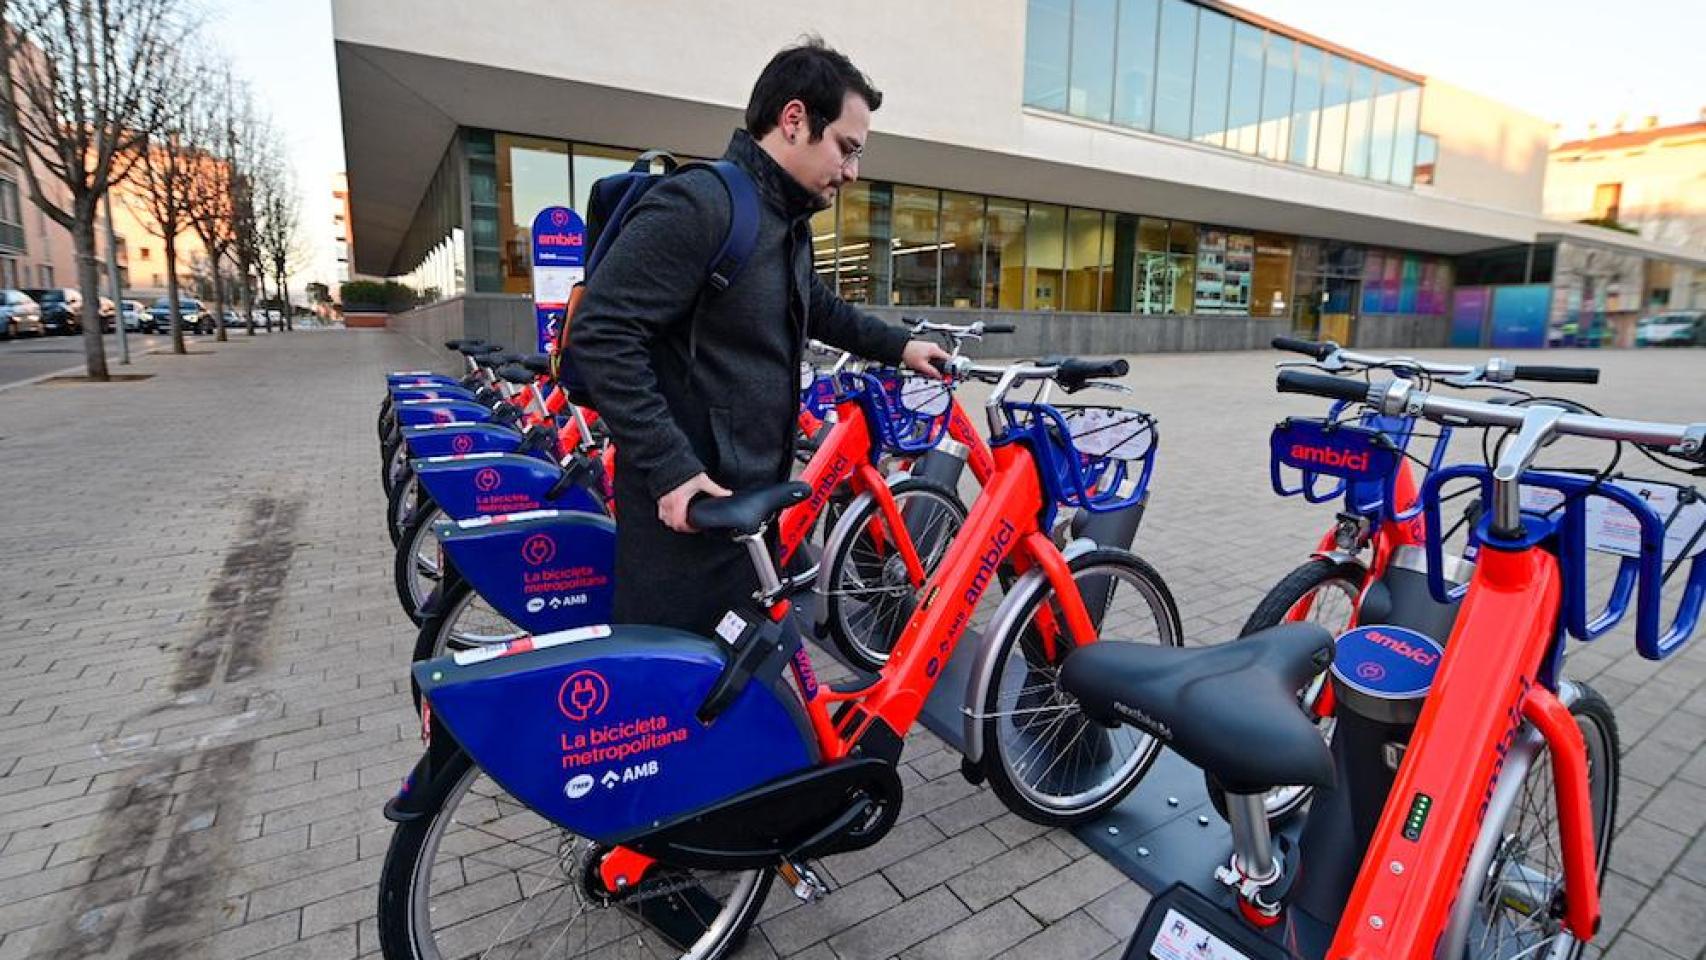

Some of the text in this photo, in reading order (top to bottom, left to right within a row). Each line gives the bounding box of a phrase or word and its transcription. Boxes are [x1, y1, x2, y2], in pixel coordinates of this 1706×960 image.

[538, 232, 582, 246] ambici
[1291, 444, 1369, 471] ambici
[965, 518, 1015, 606] ambici
[524, 572, 540, 582] La
[562, 593, 588, 606] AMB
[1365, 631, 1438, 665] ambici
[561, 716, 667, 751] La bicicleta
[562, 728, 688, 768] metropolitana
[622, 760, 659, 783] AMB
